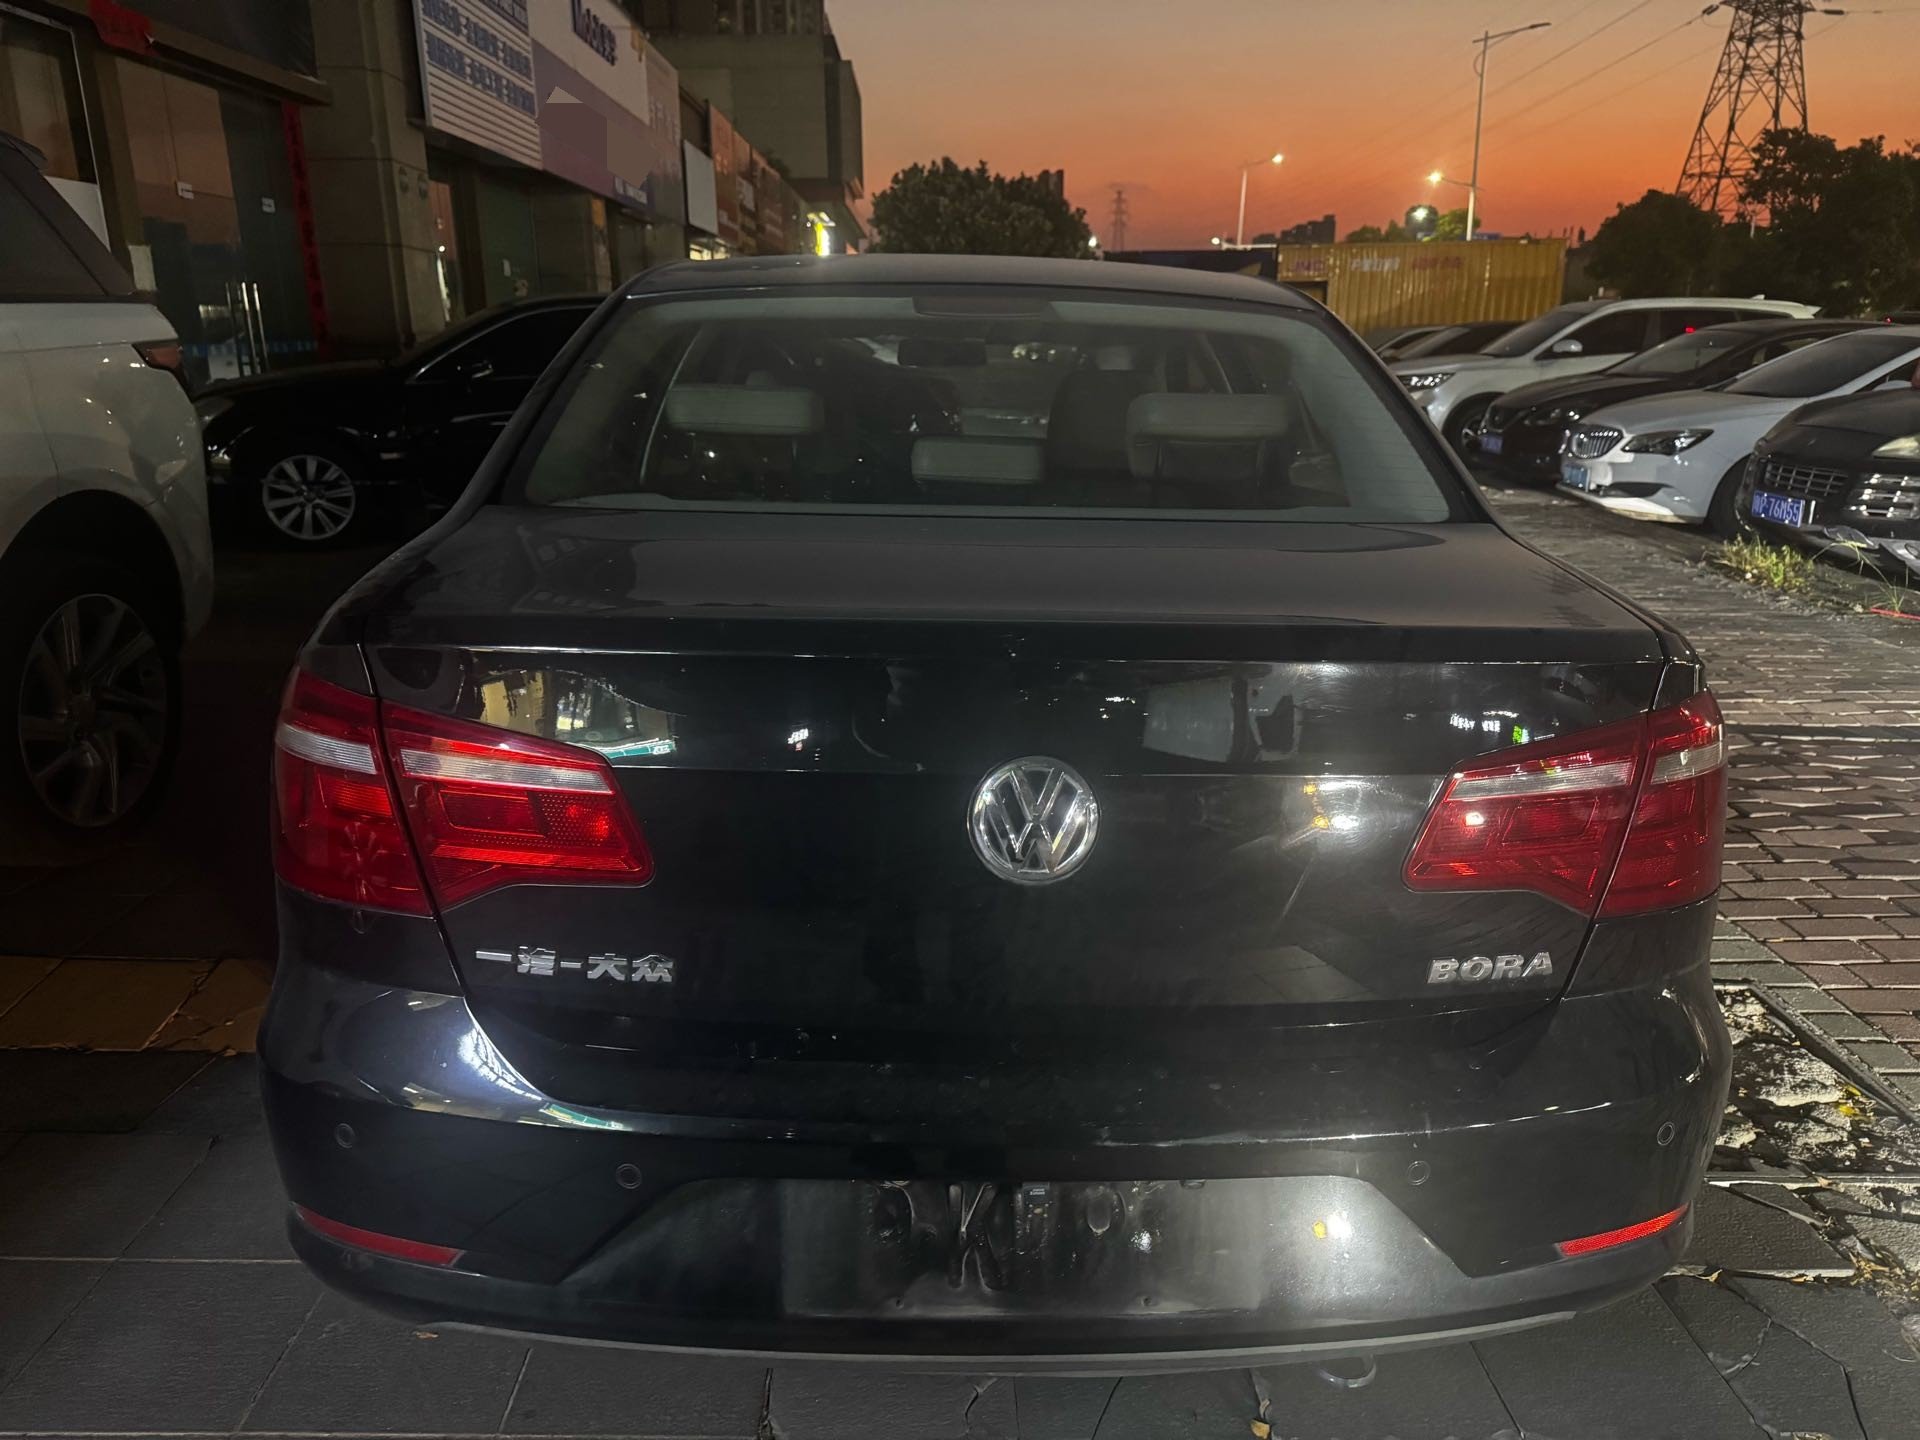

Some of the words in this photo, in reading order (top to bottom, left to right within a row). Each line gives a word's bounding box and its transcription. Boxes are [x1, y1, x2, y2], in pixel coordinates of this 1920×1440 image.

[475, 945, 674, 983] 一汽-大众
[1427, 951, 1553, 984] BORA
